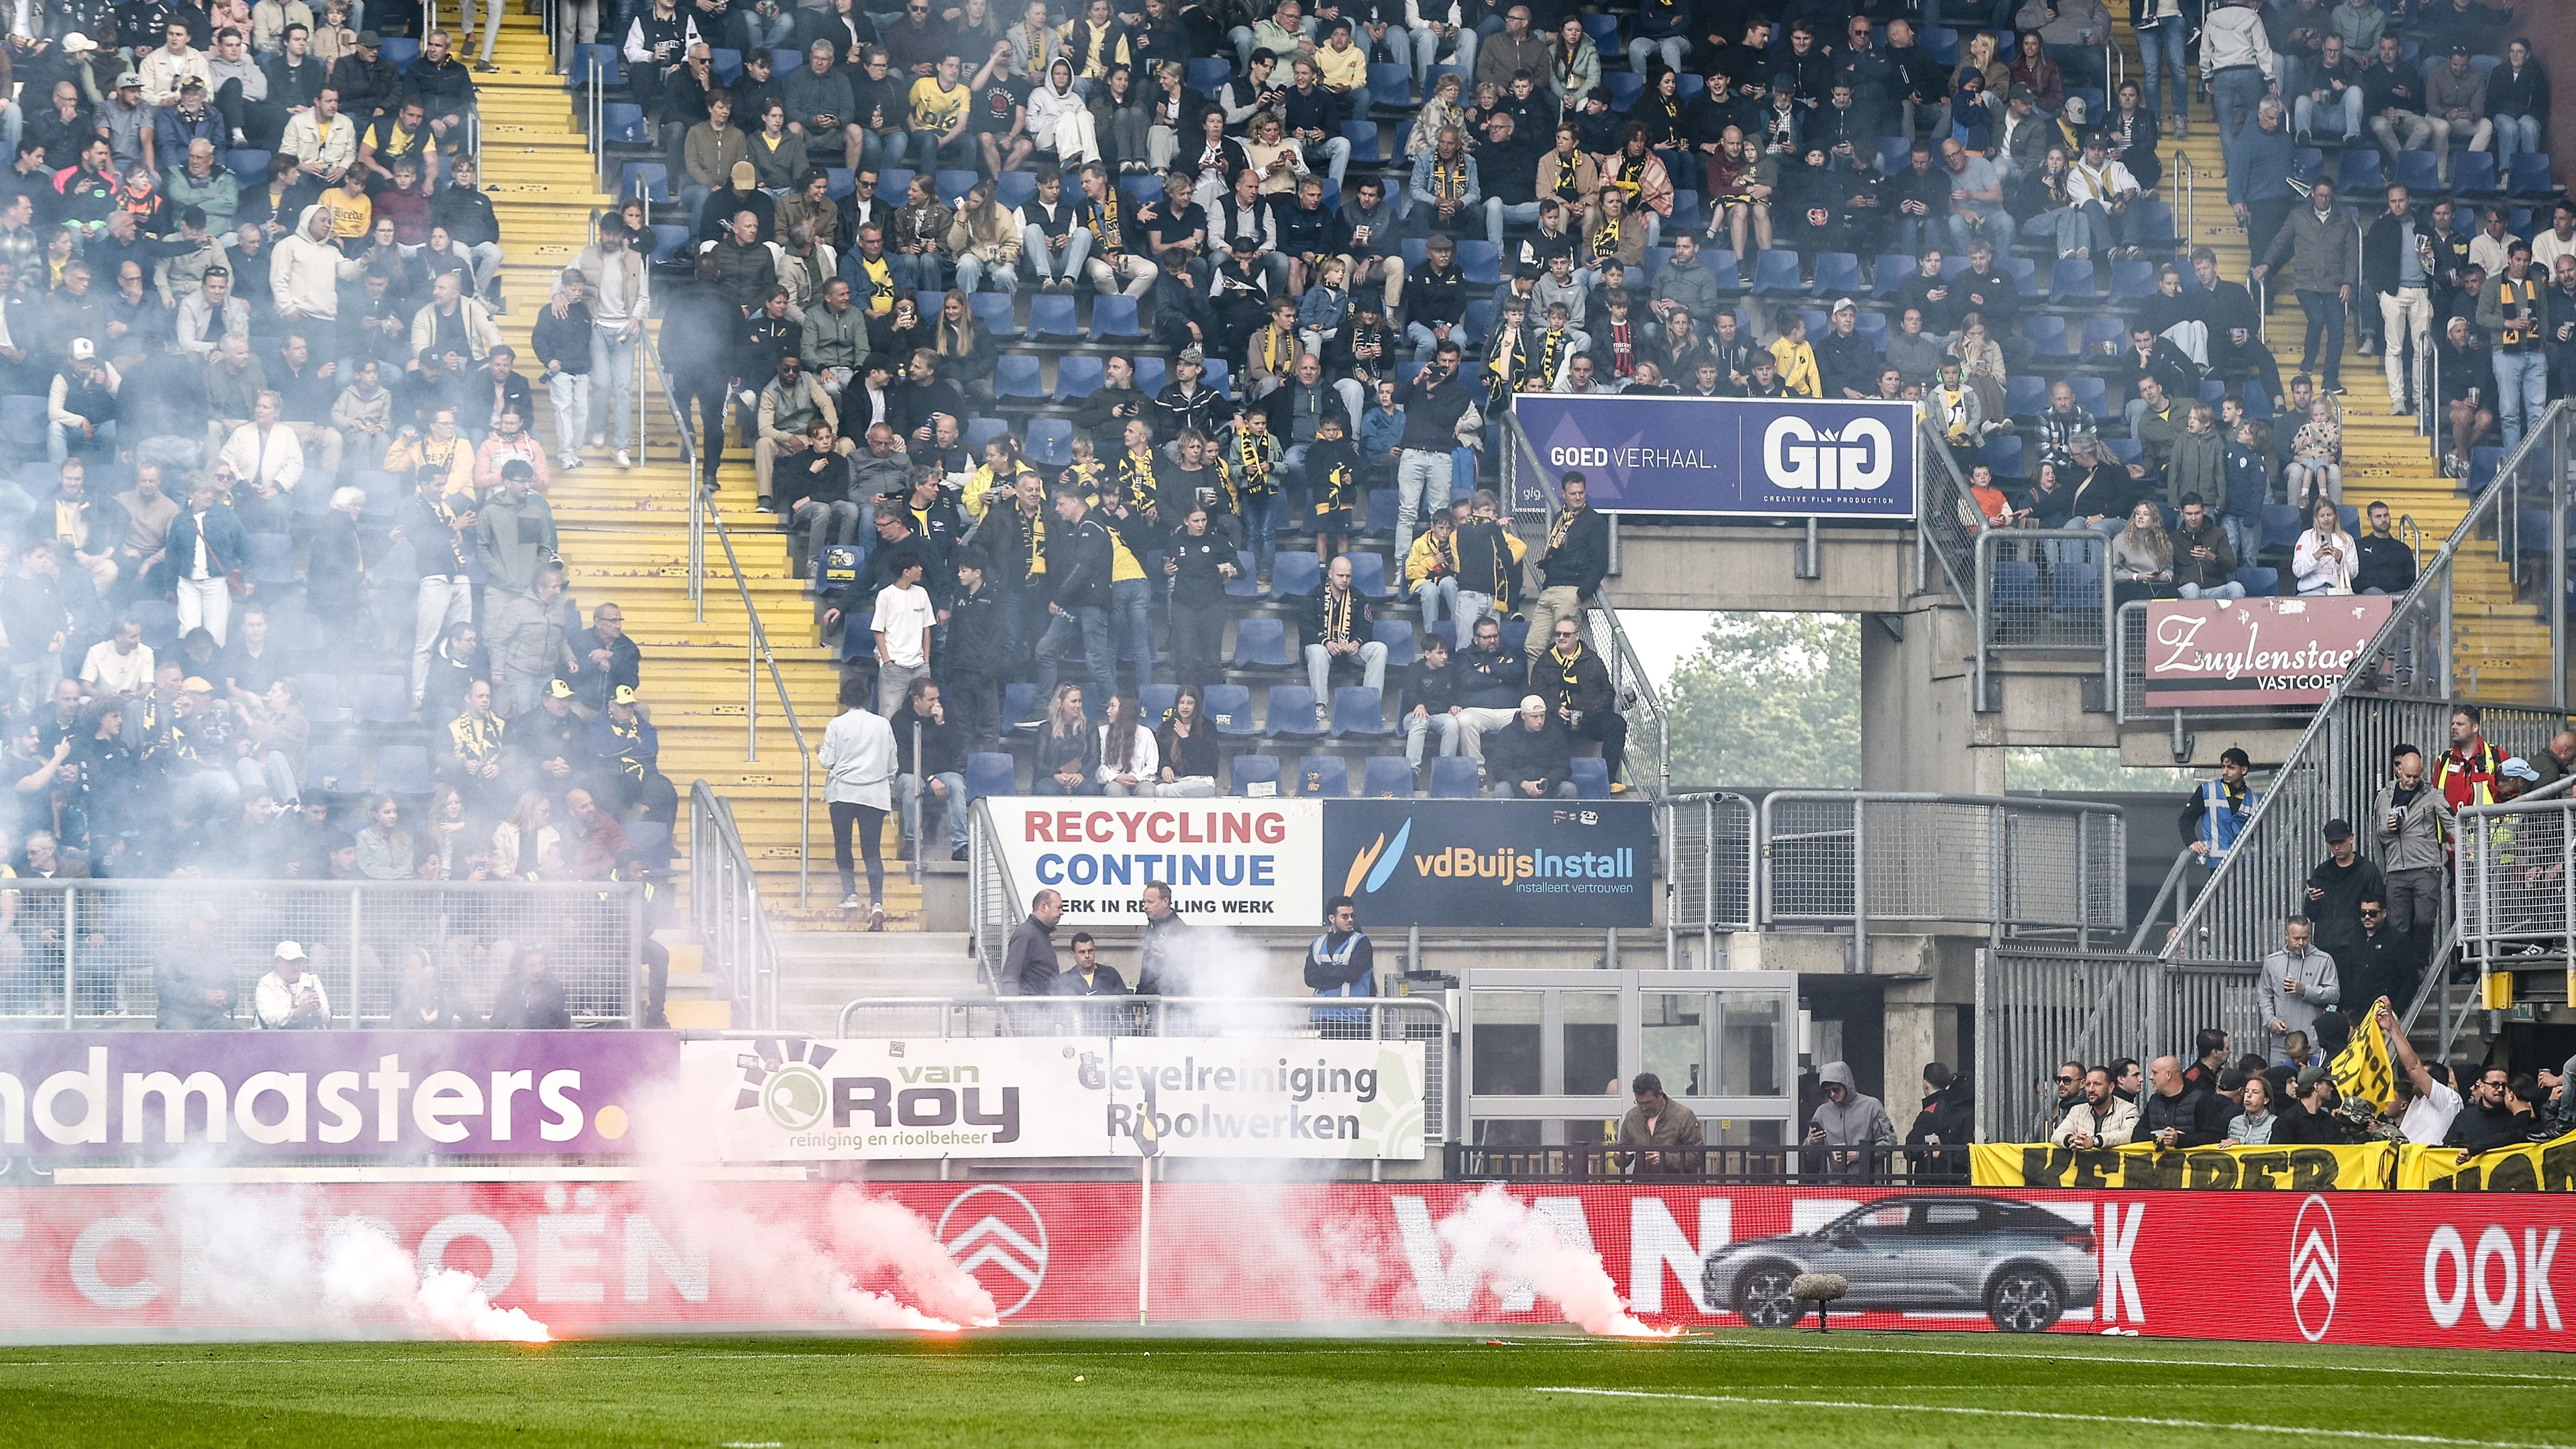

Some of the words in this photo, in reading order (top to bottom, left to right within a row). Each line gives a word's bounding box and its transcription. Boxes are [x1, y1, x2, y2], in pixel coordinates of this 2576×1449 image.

[333, 206, 363, 221] Breda
[1550, 447, 1608, 467] GOED
[1613, 447, 1717, 469] VERHAAL.
[1764, 495, 1807, 503] CREATIVE
[1837, 496, 1894, 504] PRODUCTION
[1024, 810, 1285, 844] RECYCLING
[1035, 853, 1275, 887] CONTINUE
[1414, 847, 1633, 886] vdBuijsInstall
[1516, 881, 1570, 893] installeert
[1572, 883, 1633, 894] vertrouwen
[1061, 900, 1095, 913] ERK
[1102, 900, 1120, 913] IN
[1126, 900, 1216, 914] RELING
[1222, 900, 1275, 914] WERK
[898, 1065, 979, 1083] van
[1078, 1056, 1378, 1102] Gevelreiniging
[833, 1077, 1020, 1144] Roy
[790, 1134, 862, 1150] reiniging
[868, 1133, 887, 1146] en
[893, 1130, 987, 1146] rioolbeheer
[69, 1186, 709, 1309] CIOËN
[2423, 1223, 2564, 1331] OOK
